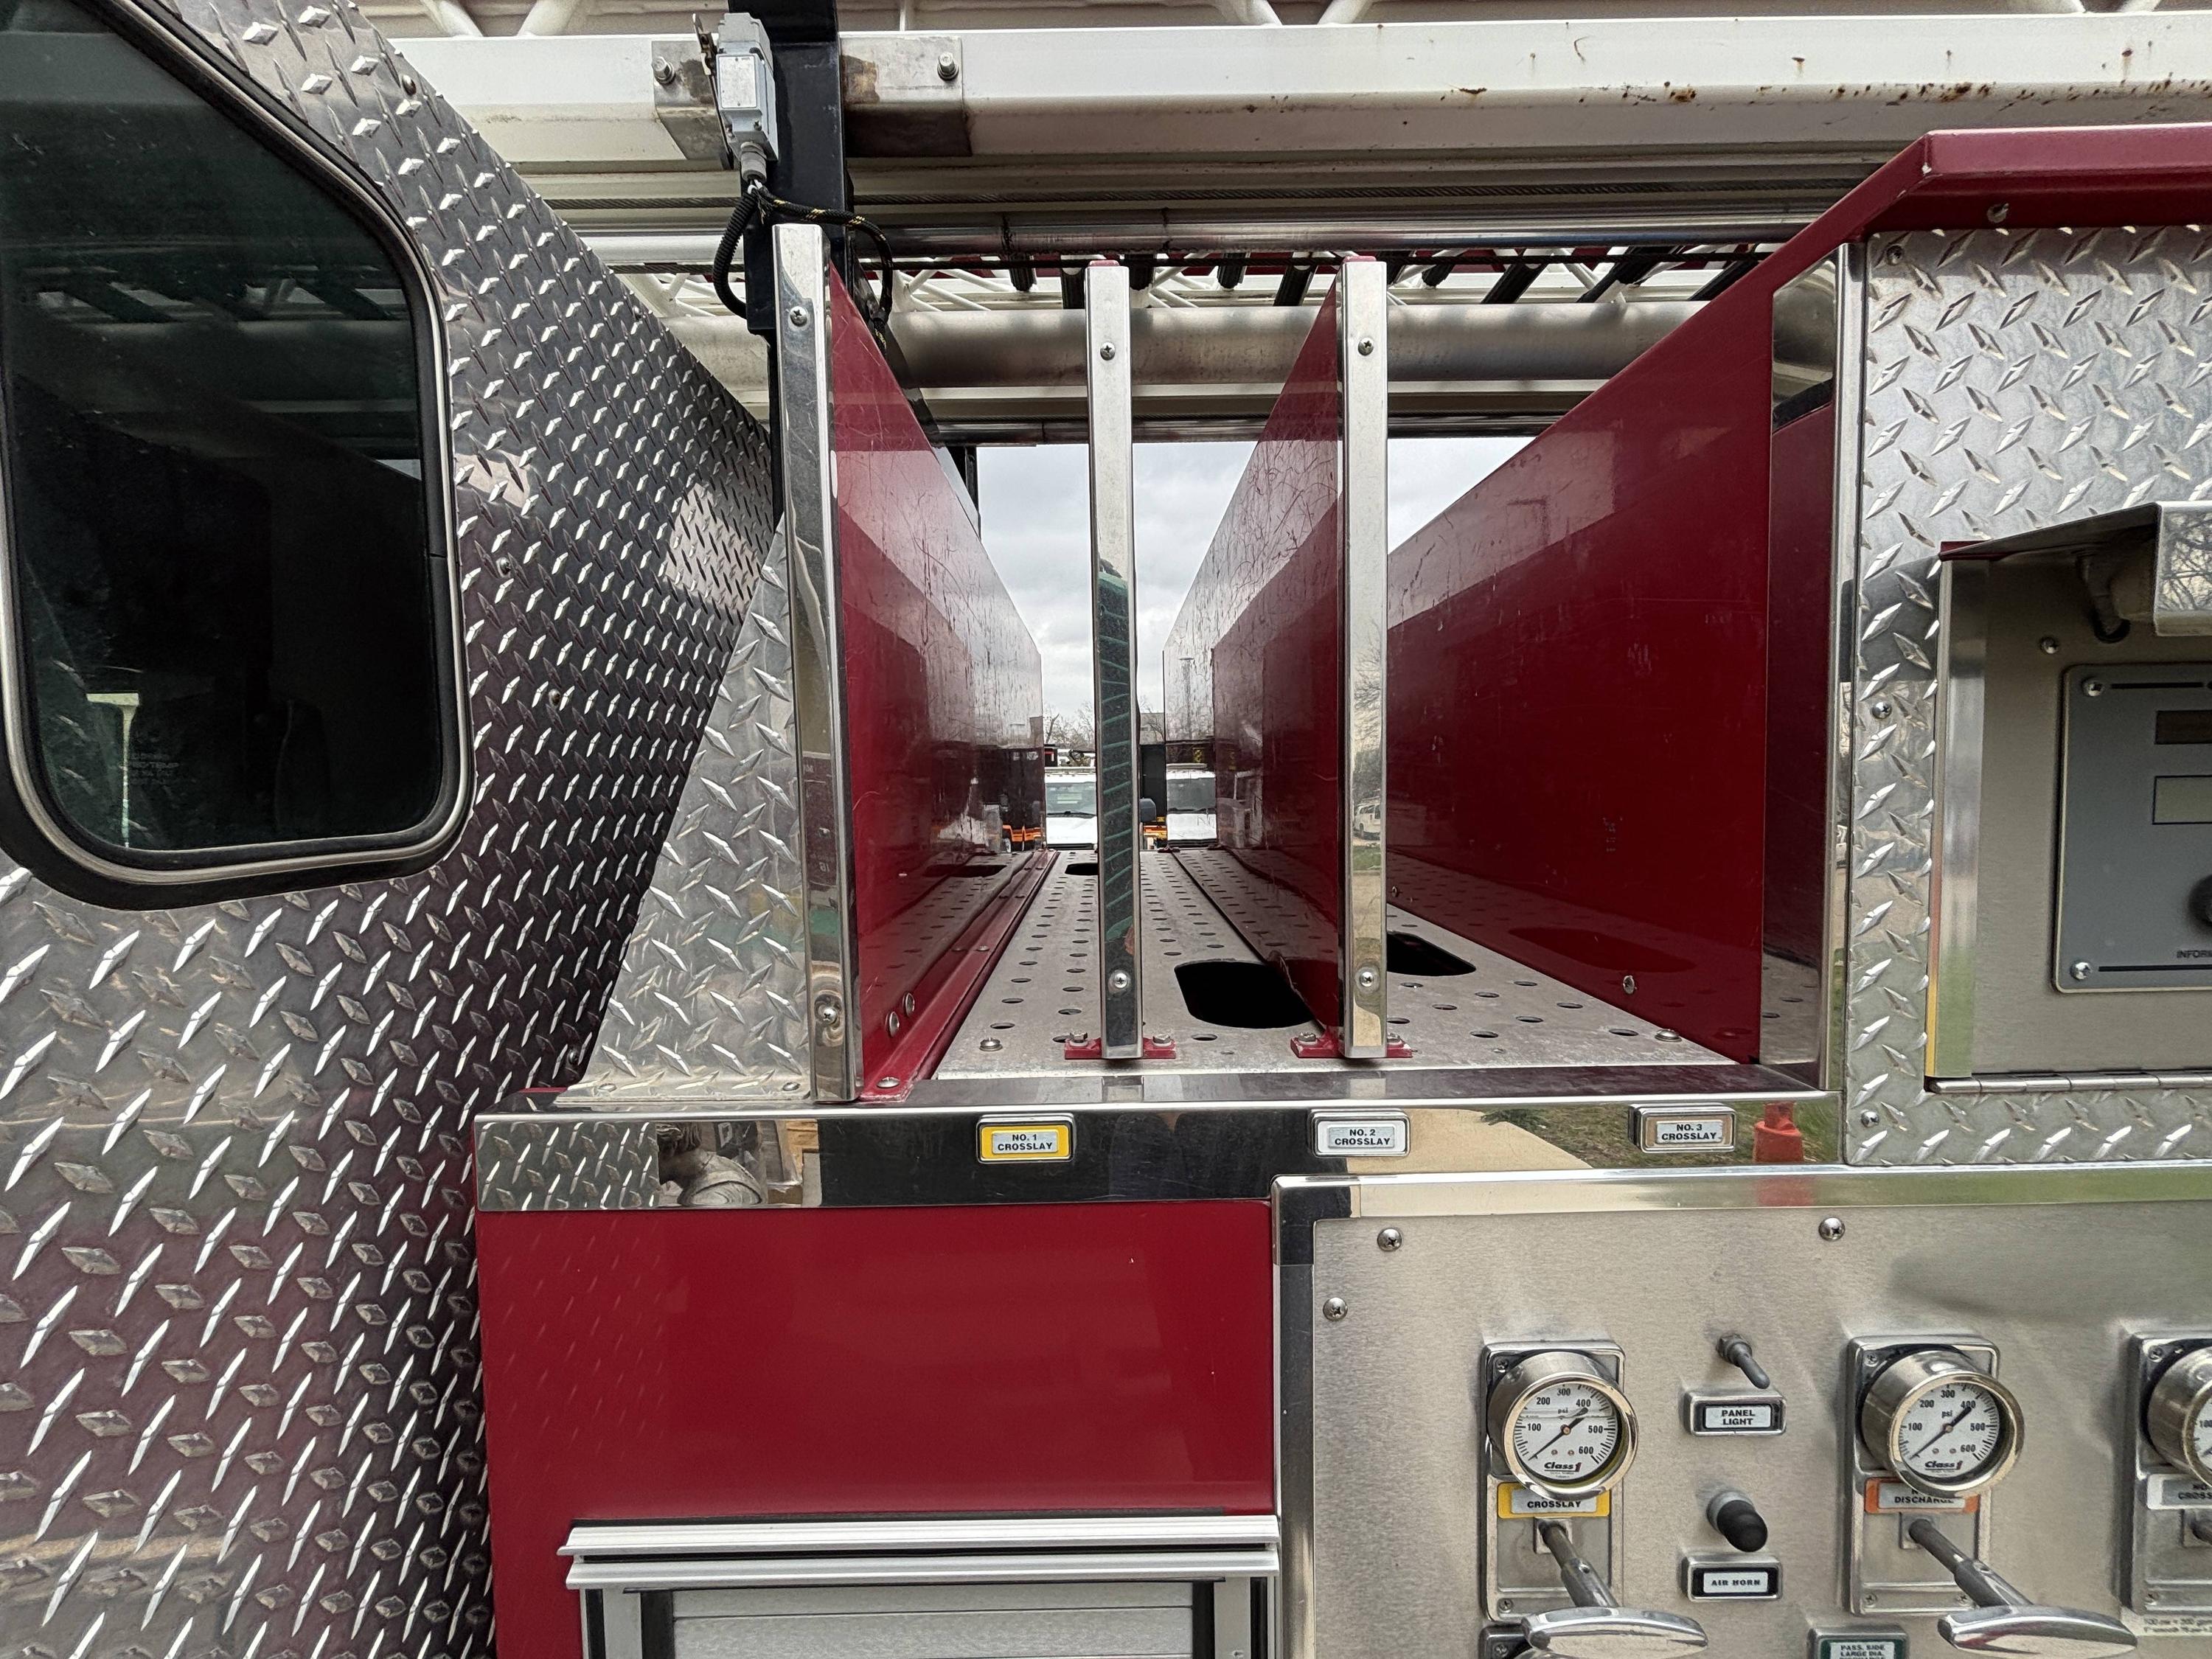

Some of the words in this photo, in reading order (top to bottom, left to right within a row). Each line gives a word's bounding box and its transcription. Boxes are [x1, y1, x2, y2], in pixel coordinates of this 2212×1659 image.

[1661, 1132, 1717, 1140] CROSSLAY
[998, 1142, 1052, 1150] CROSSLAY
[1557, 1388, 1571, 1396] 300
[1941, 1390, 1955, 1398] 300
[1536, 1397, 1551, 1405] 200
[1576, 1399, 1591, 1407] 400
[1919, 1399, 1934, 1408] 200
[1961, 1400, 1976, 1408] 400
[1941, 1410, 1952, 1418] psi
[1527, 1423, 1542, 1431] 100
[1588, 1425, 1603, 1433] 500
[1908, 1422, 1922, 1430] 100
[1970, 1423, 1985, 1431] 500
[1579, 1446, 1594, 1455] 600
[1961, 1444, 1976, 1453] 600
[1527, 1500, 1582, 1509] CROSSLAY
